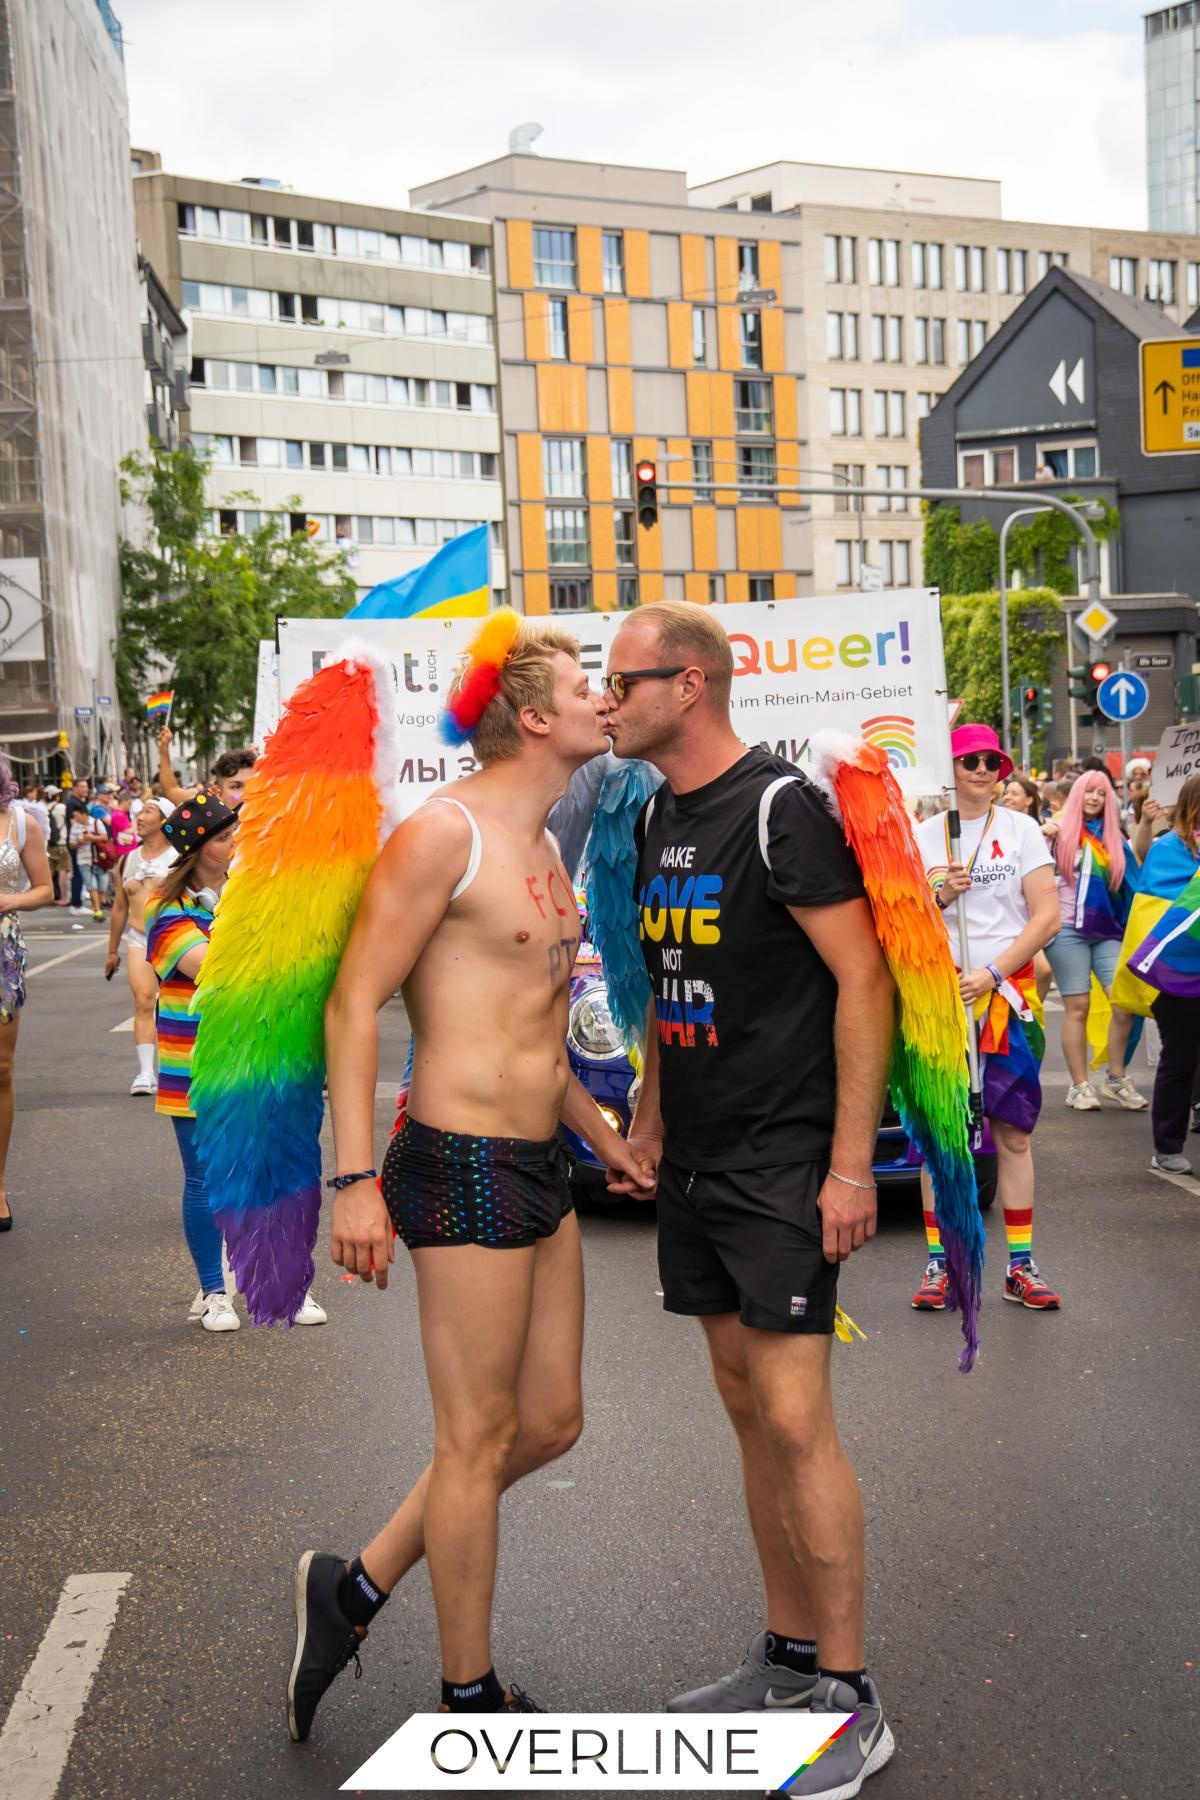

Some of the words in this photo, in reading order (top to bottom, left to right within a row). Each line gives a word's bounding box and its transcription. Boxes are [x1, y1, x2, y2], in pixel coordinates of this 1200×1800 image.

[727, 621, 911, 677] Queer!
[740, 695, 759, 708] im
[765, 685, 913, 706] Rhein-Main-Gebiet
[397, 712, 440, 728] Vago
[660, 846, 697, 869] MAKE
[971, 872, 1006, 885] agon
[972, 863, 1016, 876] oluboy
[662, 948, 682, 971] NOT
